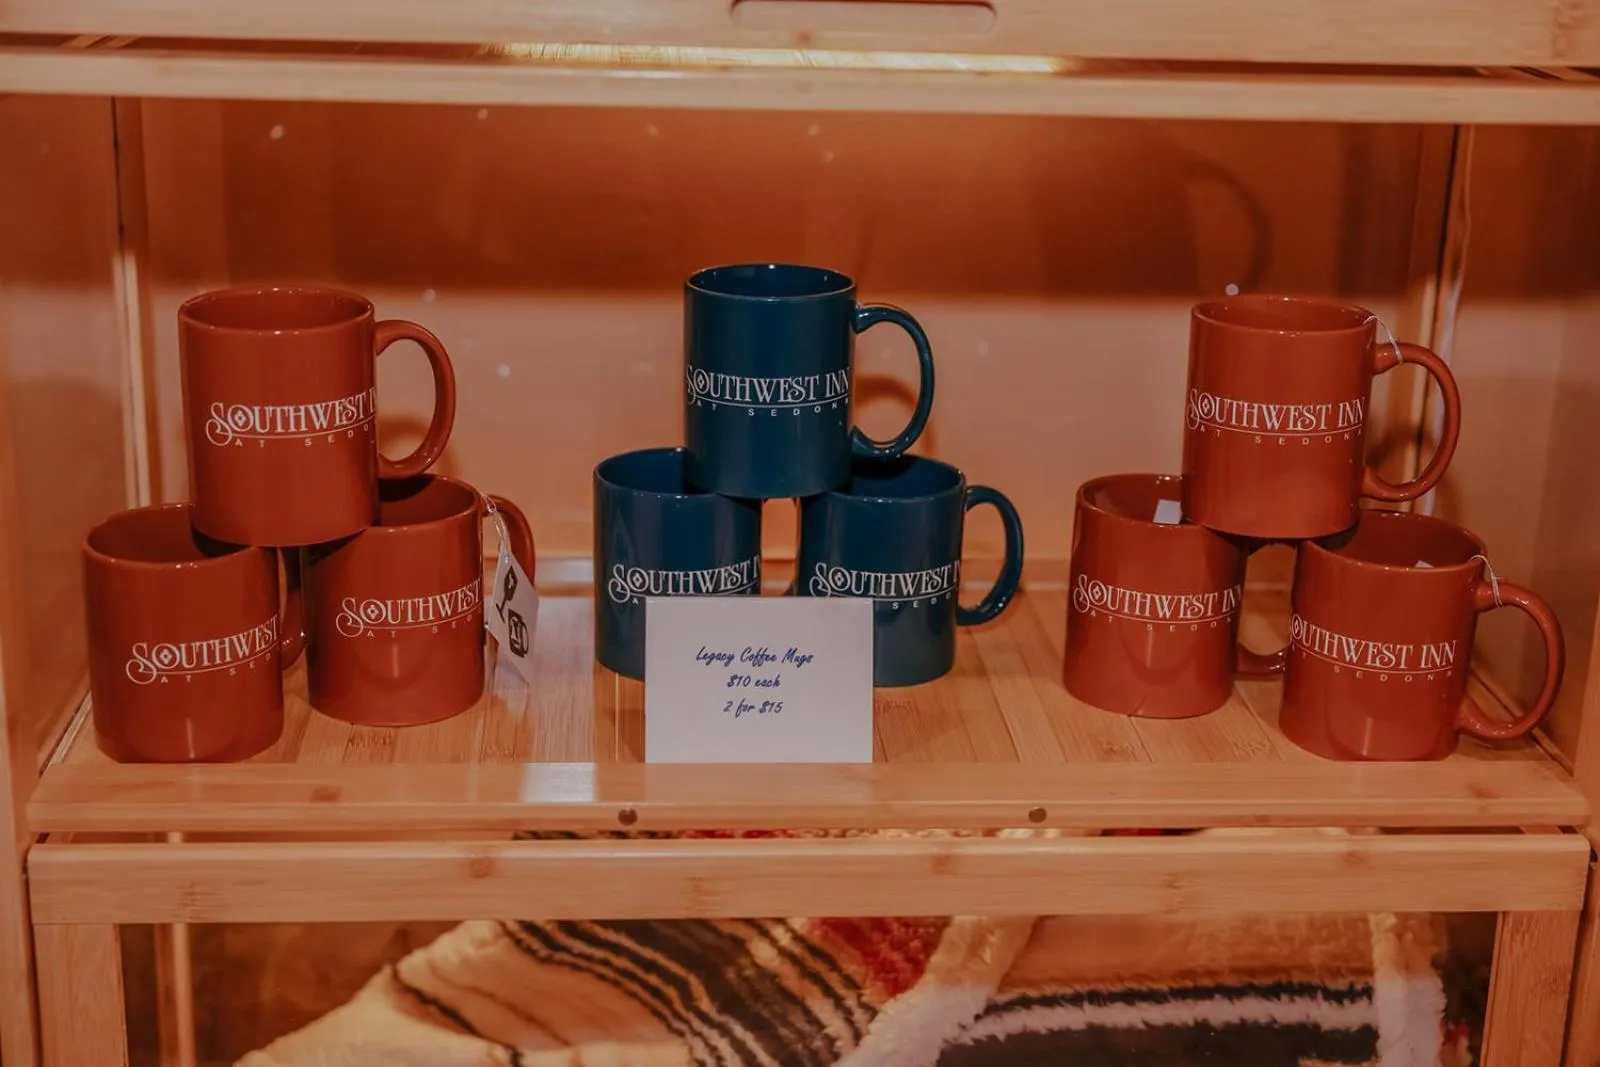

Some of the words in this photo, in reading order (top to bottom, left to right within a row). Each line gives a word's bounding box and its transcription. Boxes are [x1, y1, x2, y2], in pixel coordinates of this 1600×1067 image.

[687, 365, 820, 406] SOUTHWEST
[205, 391, 367, 446] SOUTHWEST
[1186, 388, 1331, 431] SOUTHWEST
[304, 423, 369, 447] SEDO
[608, 563, 751, 603] SOUTHWEST
[809, 562, 952, 597] SOUTHWEST
[1073, 573, 1217, 619] SOUTHWEST
[334, 576, 481, 638] SOUTHWEST
[125, 612, 278, 685] SOUTHWEST
[696, 646, 735, 668] Legacy
[740, 646, 778, 668] Coffee
[781, 646, 814, 669] Mugs
[1290, 613, 1413, 669] OUTHWEST
[1419, 640, 1457, 669] INN
[727, 674, 751, 687] $10
[754, 674, 781, 687] each
[723, 701, 733, 713] 2
[735, 698, 755, 718] for
[759, 700, 783, 714] $15
